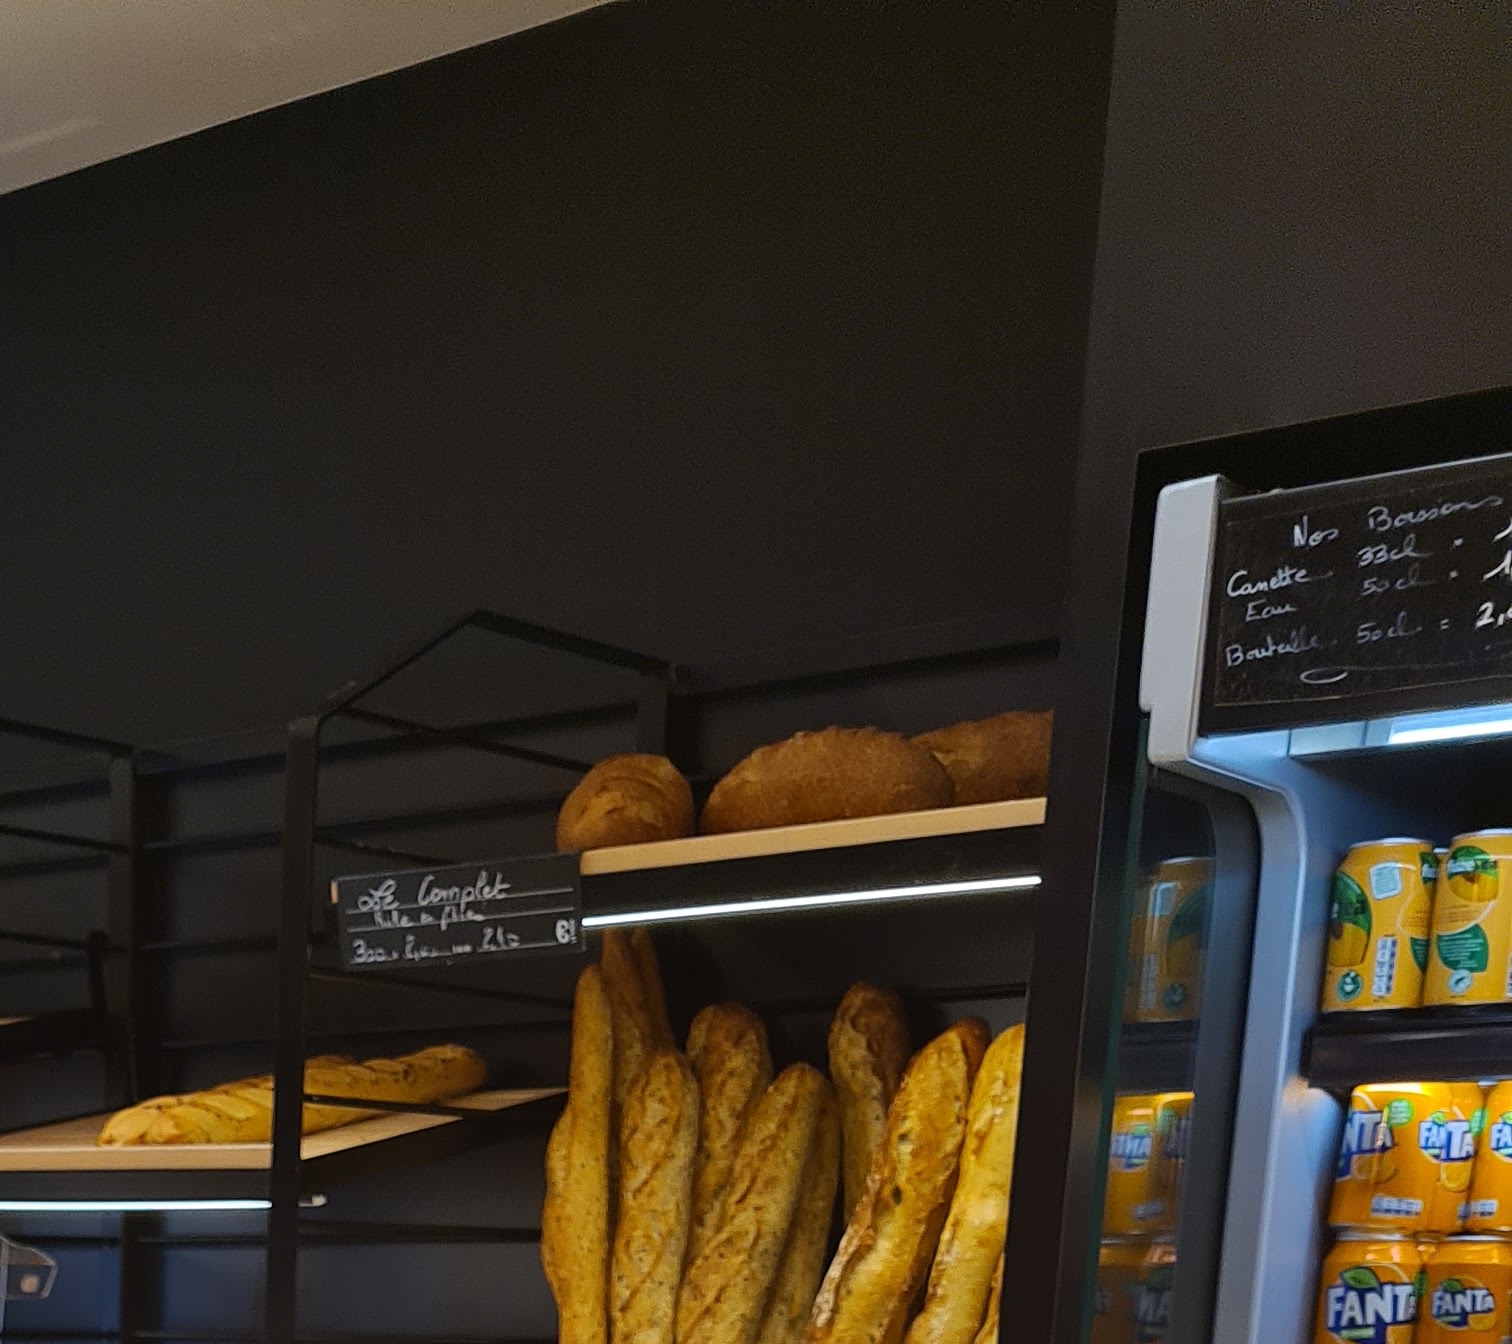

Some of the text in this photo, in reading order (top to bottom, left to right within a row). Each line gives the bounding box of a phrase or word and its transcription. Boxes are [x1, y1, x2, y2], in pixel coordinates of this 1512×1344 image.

[1245, 599, 1297, 622] Eau
[1327, 1283, 1416, 1330] FANTA
[1432, 1287, 1494, 1318] FANTA
